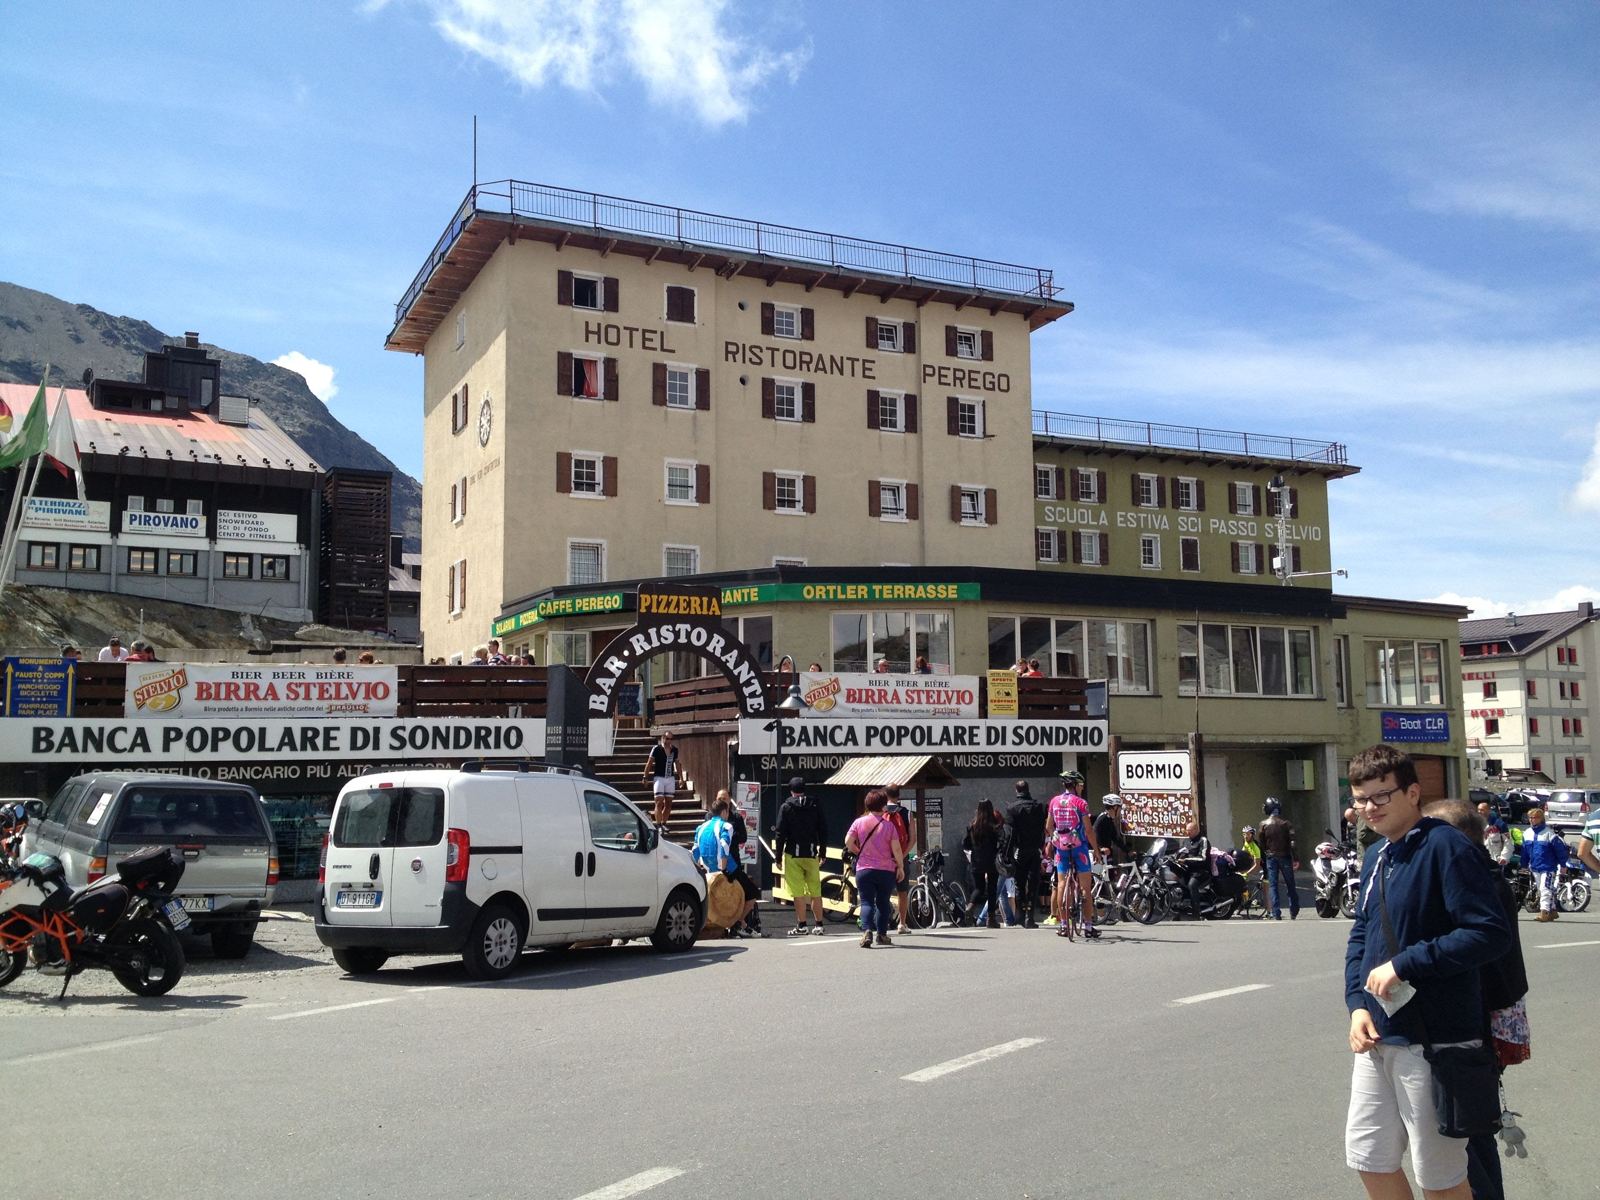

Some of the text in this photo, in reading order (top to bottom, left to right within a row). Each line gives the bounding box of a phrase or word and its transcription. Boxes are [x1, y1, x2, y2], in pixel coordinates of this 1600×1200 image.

[585, 321, 676, 353] HOTEL
[724, 341, 876, 380] RISTORANTE
[922, 364, 1011, 393] PEREGO
[129, 513, 199, 529] PIROVANO
[1044, 506, 1109, 526] SCUOLA
[1117, 511, 1170, 531] ESTIVA
[1177, 516, 1202, 533] SCI
[1210, 518, 1257, 537] PASSO
[803, 585, 958, 600] ORTLER TERRASSE
[575, 595, 620, 612] PEREGO
[639, 593, 721, 616] PIZZERIA
[231, 669, 354, 680] BIER BEER BIÈRE
[589, 623, 766, 713] BAR RISTORANTE
[135, 674, 184, 705] STELVIO
[195, 681, 390, 701] BIRRA STELVIO
[868, 678, 950, 688] BIER BEER BIÈRE
[805, 680, 839, 705] STELVIO
[845, 688, 974, 705] BIRRA STELVIO
[566, 726, 587, 735] MUSEO
[1399, 717, 1422, 730] Boot
[31, 725, 524, 753] BANCA POPOLARE DI SONDRIO
[566, 736, 587, 744] STORICO
[781, 725, 1104, 747] BANCA POPOLARE DI SONDRIO
[798, 756, 850, 769] RIUNION
[954, 754, 993, 767] MUSEO
[998, 754, 1045, 767] STORICO
[217, 766, 301, 780] BANCARIO
[1126, 763, 1183, 779] BORMIO
[1141, 796, 1169, 807] Passo
